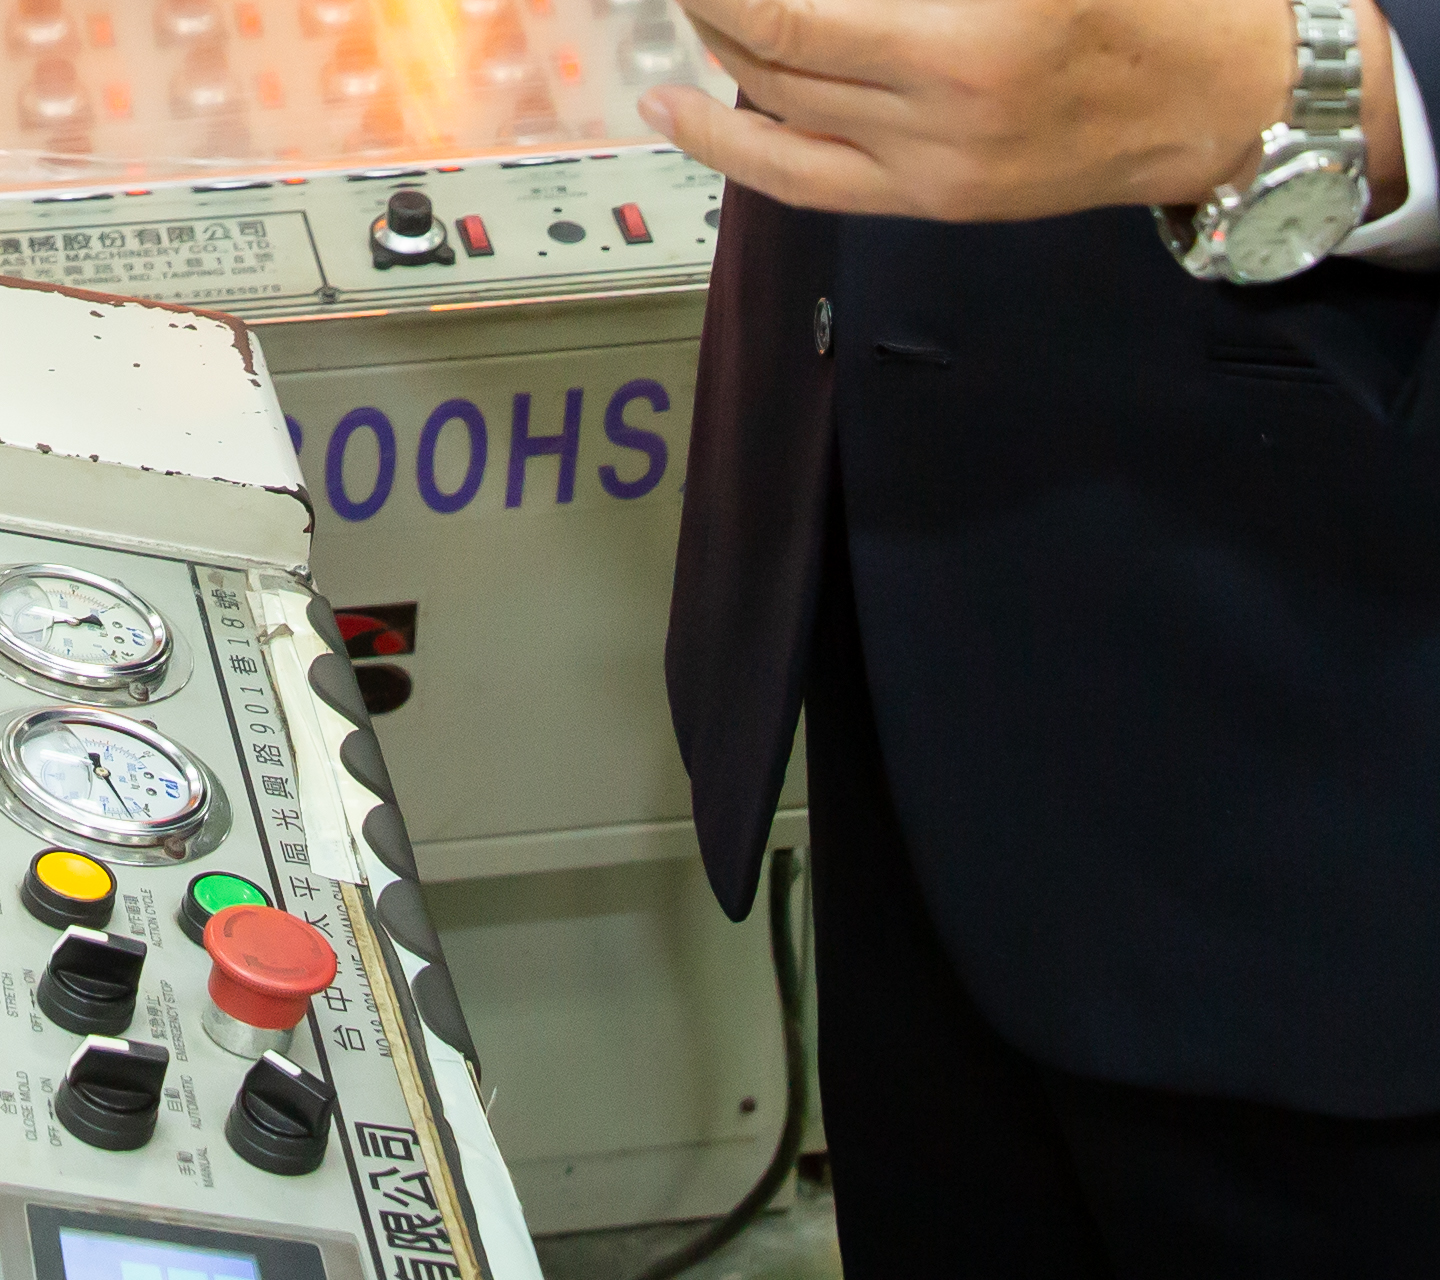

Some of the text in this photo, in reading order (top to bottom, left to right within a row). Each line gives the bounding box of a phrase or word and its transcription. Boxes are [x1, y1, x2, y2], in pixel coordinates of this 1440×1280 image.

[65, 244, 180, 263] MACHINERY
[284, 378, 671, 524] 00HS
[211, 589, 366, 1051] 台中太平區光興路901巷18號
[140, 887, 163, 949] ACTION CYCLE
[1, 971, 19, 1018] STRETCH
[23, 968, 43, 1033] OFF ON
[160, 978, 188, 1062] EMERGENCY STOP
[16, 1070, 38, 1141] CLOSE MOLD
[40, 1076, 63, 1147] OFF ON
[163, 1087, 184, 1113] 自動
[180, 1074, 202, 1130] AUTOMATIC
[176, 1150, 196, 1176] 手動
[196, 1145, 215, 1188] MANUAL
